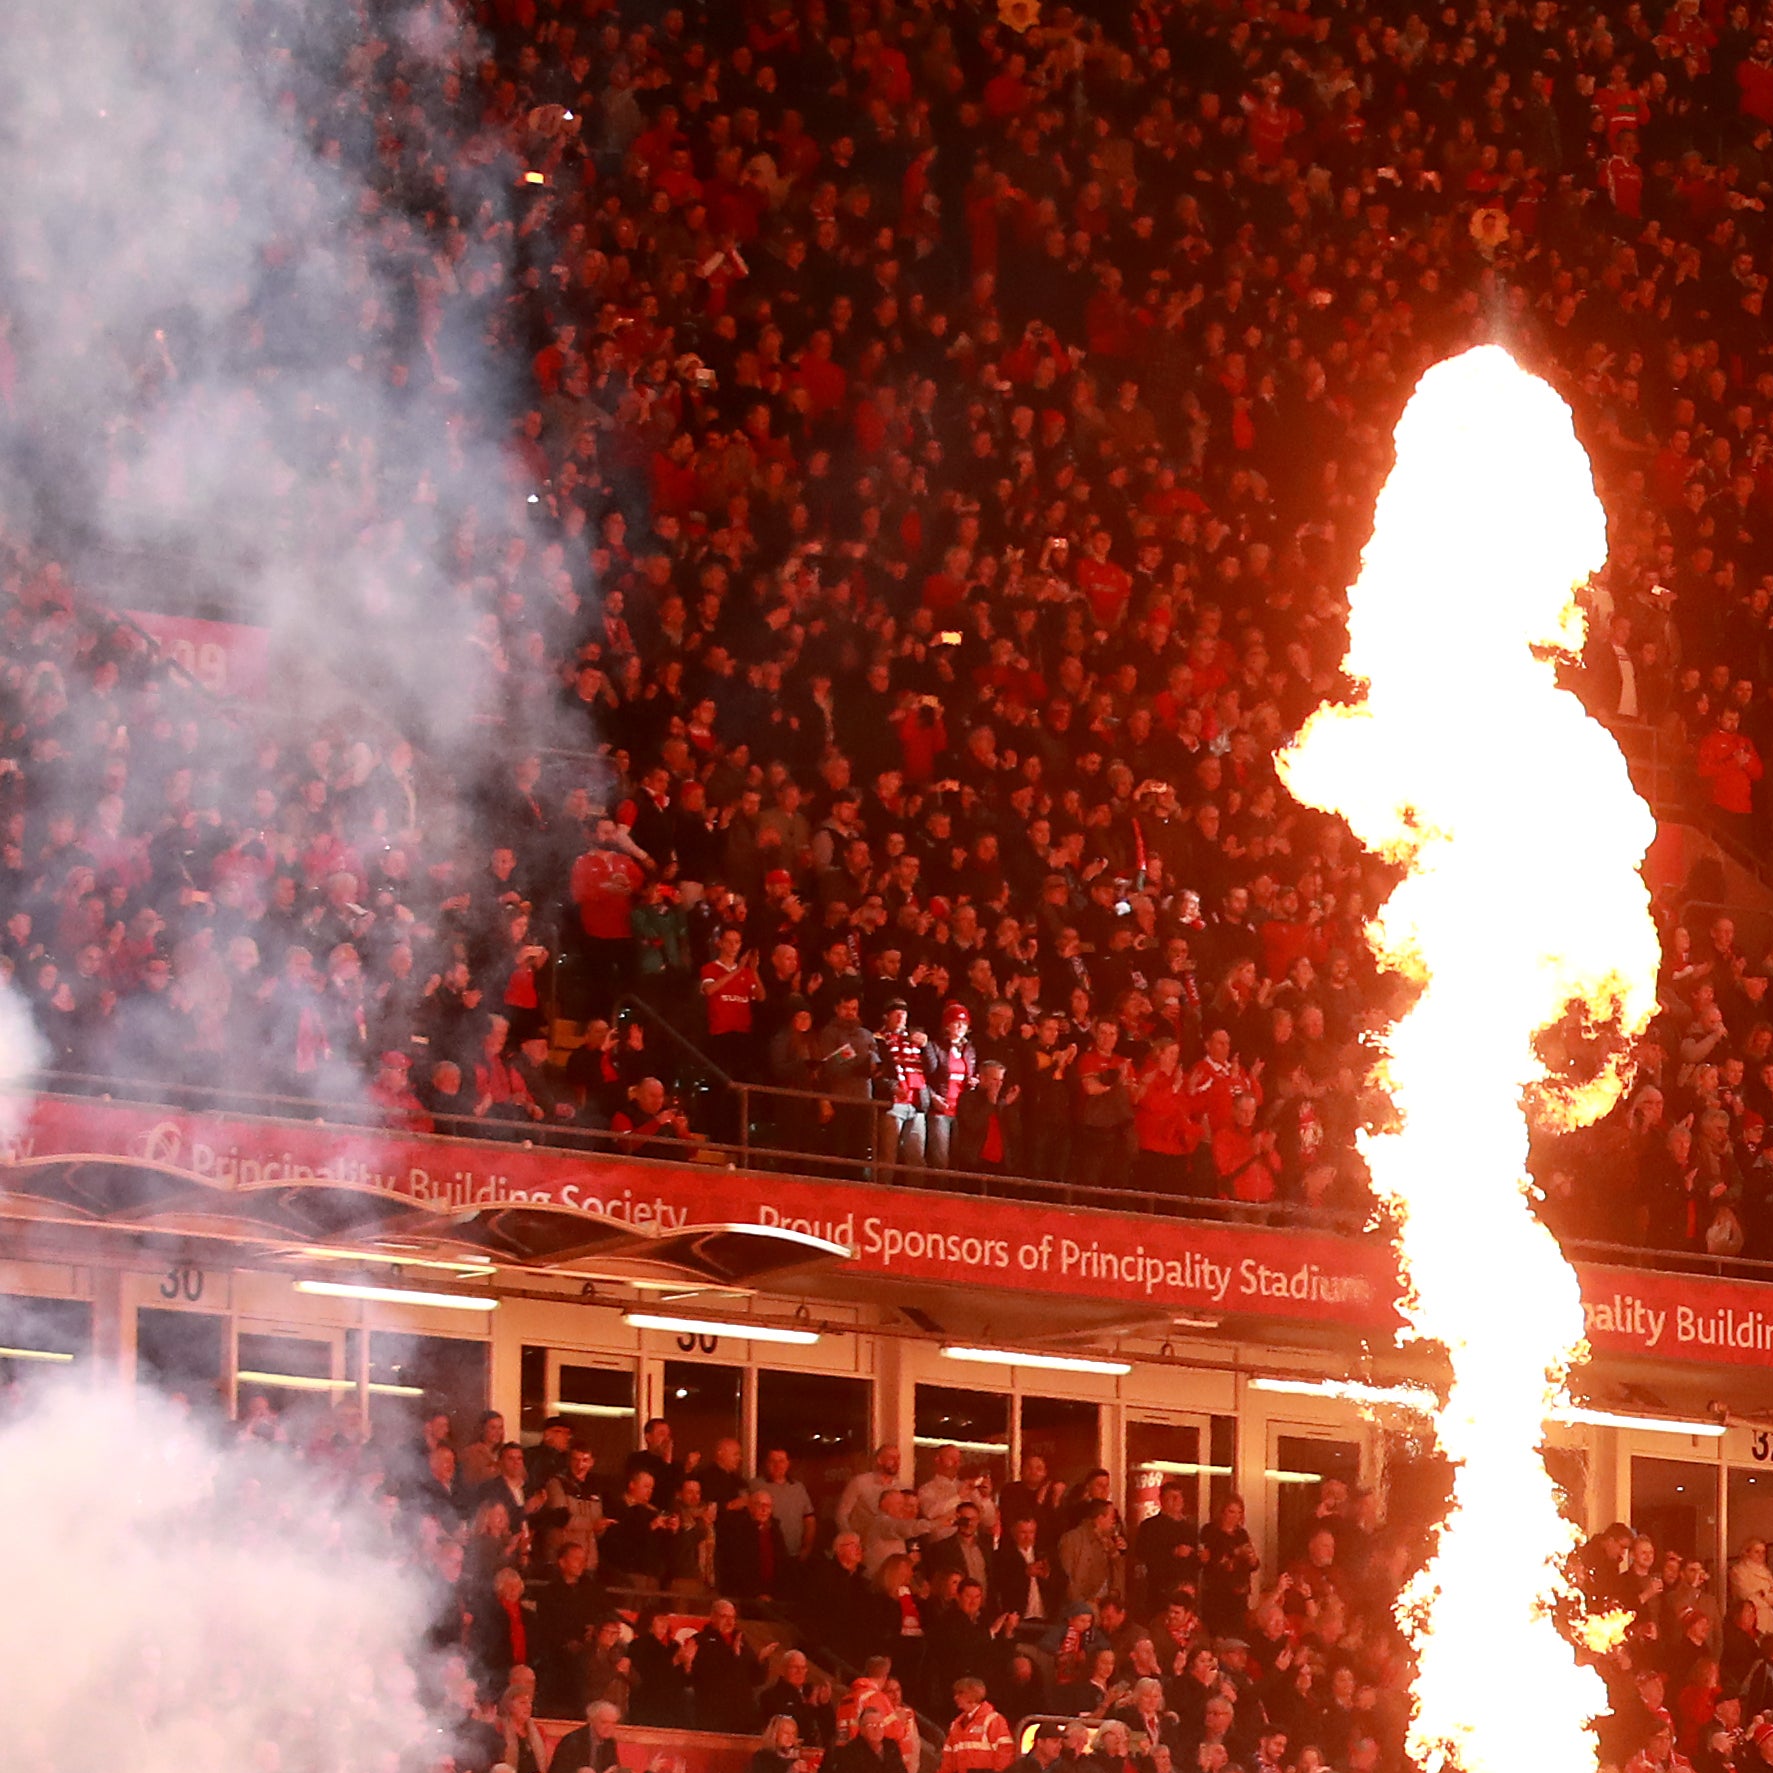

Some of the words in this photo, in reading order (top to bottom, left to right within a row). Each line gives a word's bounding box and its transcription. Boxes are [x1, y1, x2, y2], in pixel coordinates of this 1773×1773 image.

[864, 1217, 1009, 1269] Sponsors
[1019, 1235, 1051, 1272] of
[1061, 1240, 1231, 1301] Principality
